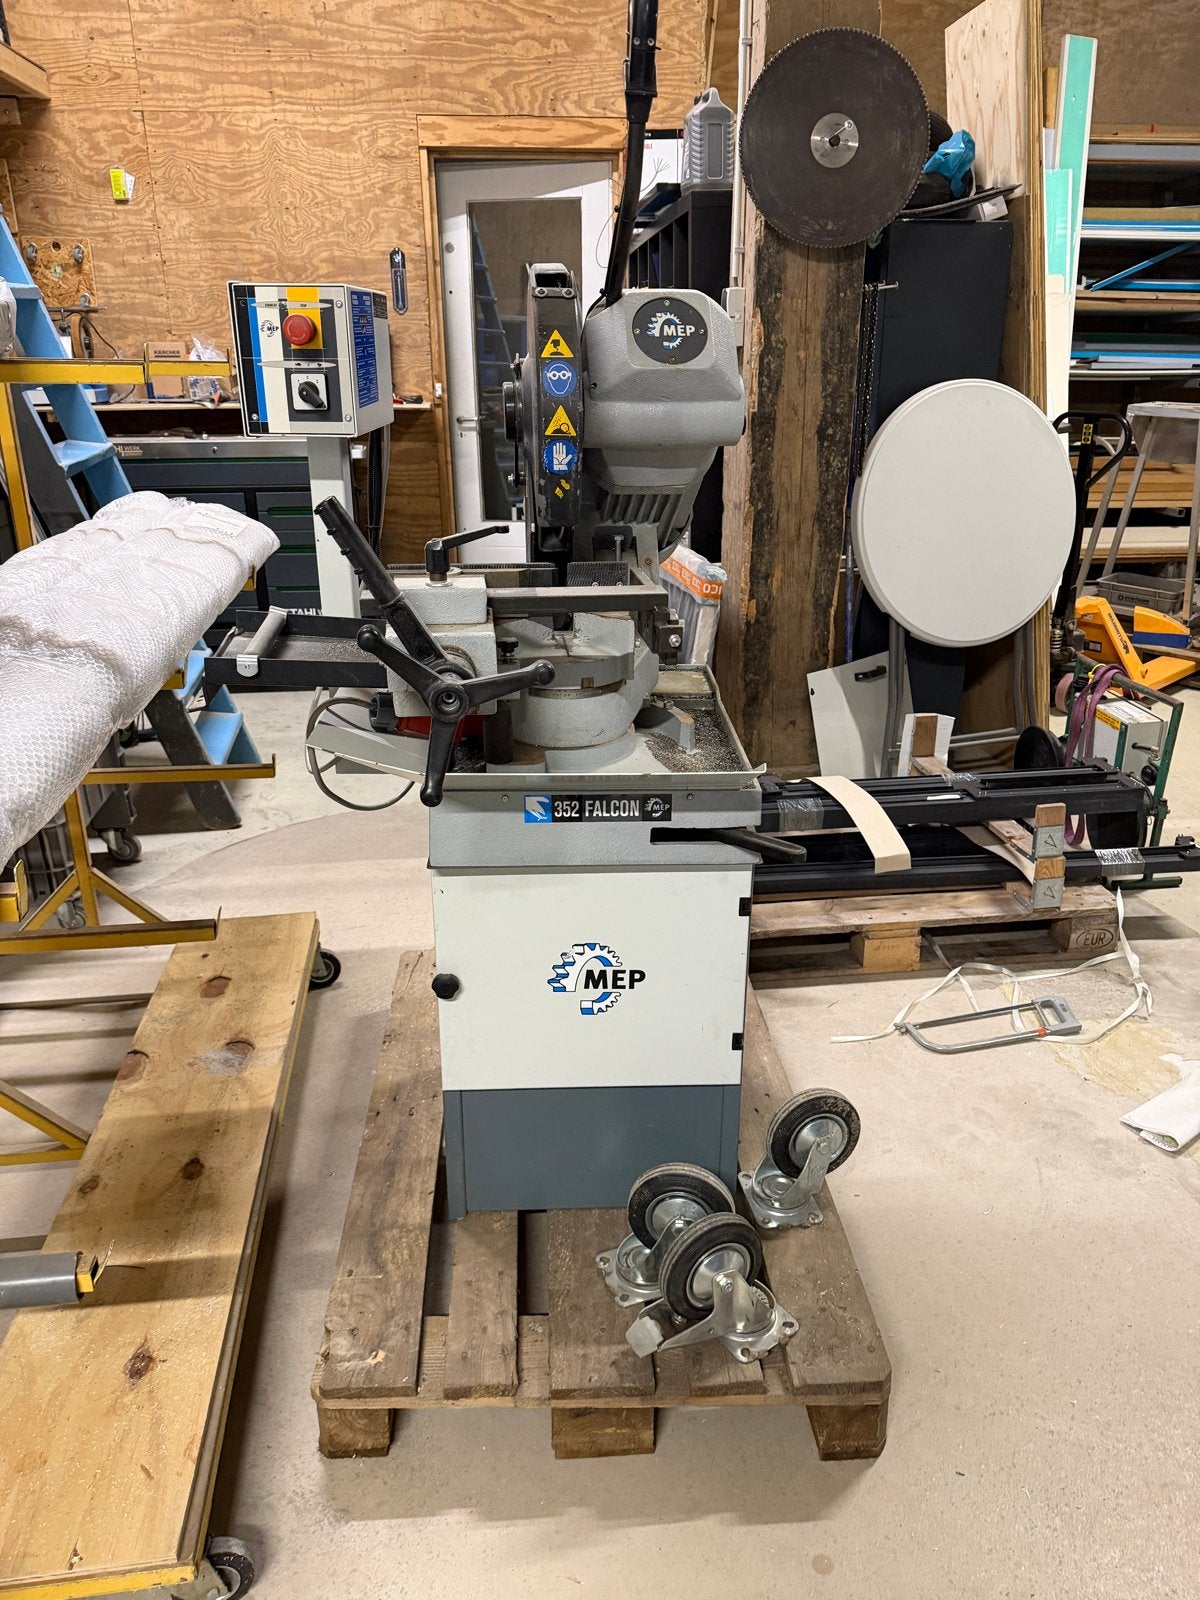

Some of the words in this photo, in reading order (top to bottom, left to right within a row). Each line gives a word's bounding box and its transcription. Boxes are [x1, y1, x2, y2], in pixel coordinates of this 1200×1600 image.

[663, 324, 695, 337] MEP
[554, 801, 579, 817] 352
[585, 800, 640, 817] FALCON
[1083, 931, 1107, 946] EUR
[584, 969, 646, 989] MEP
